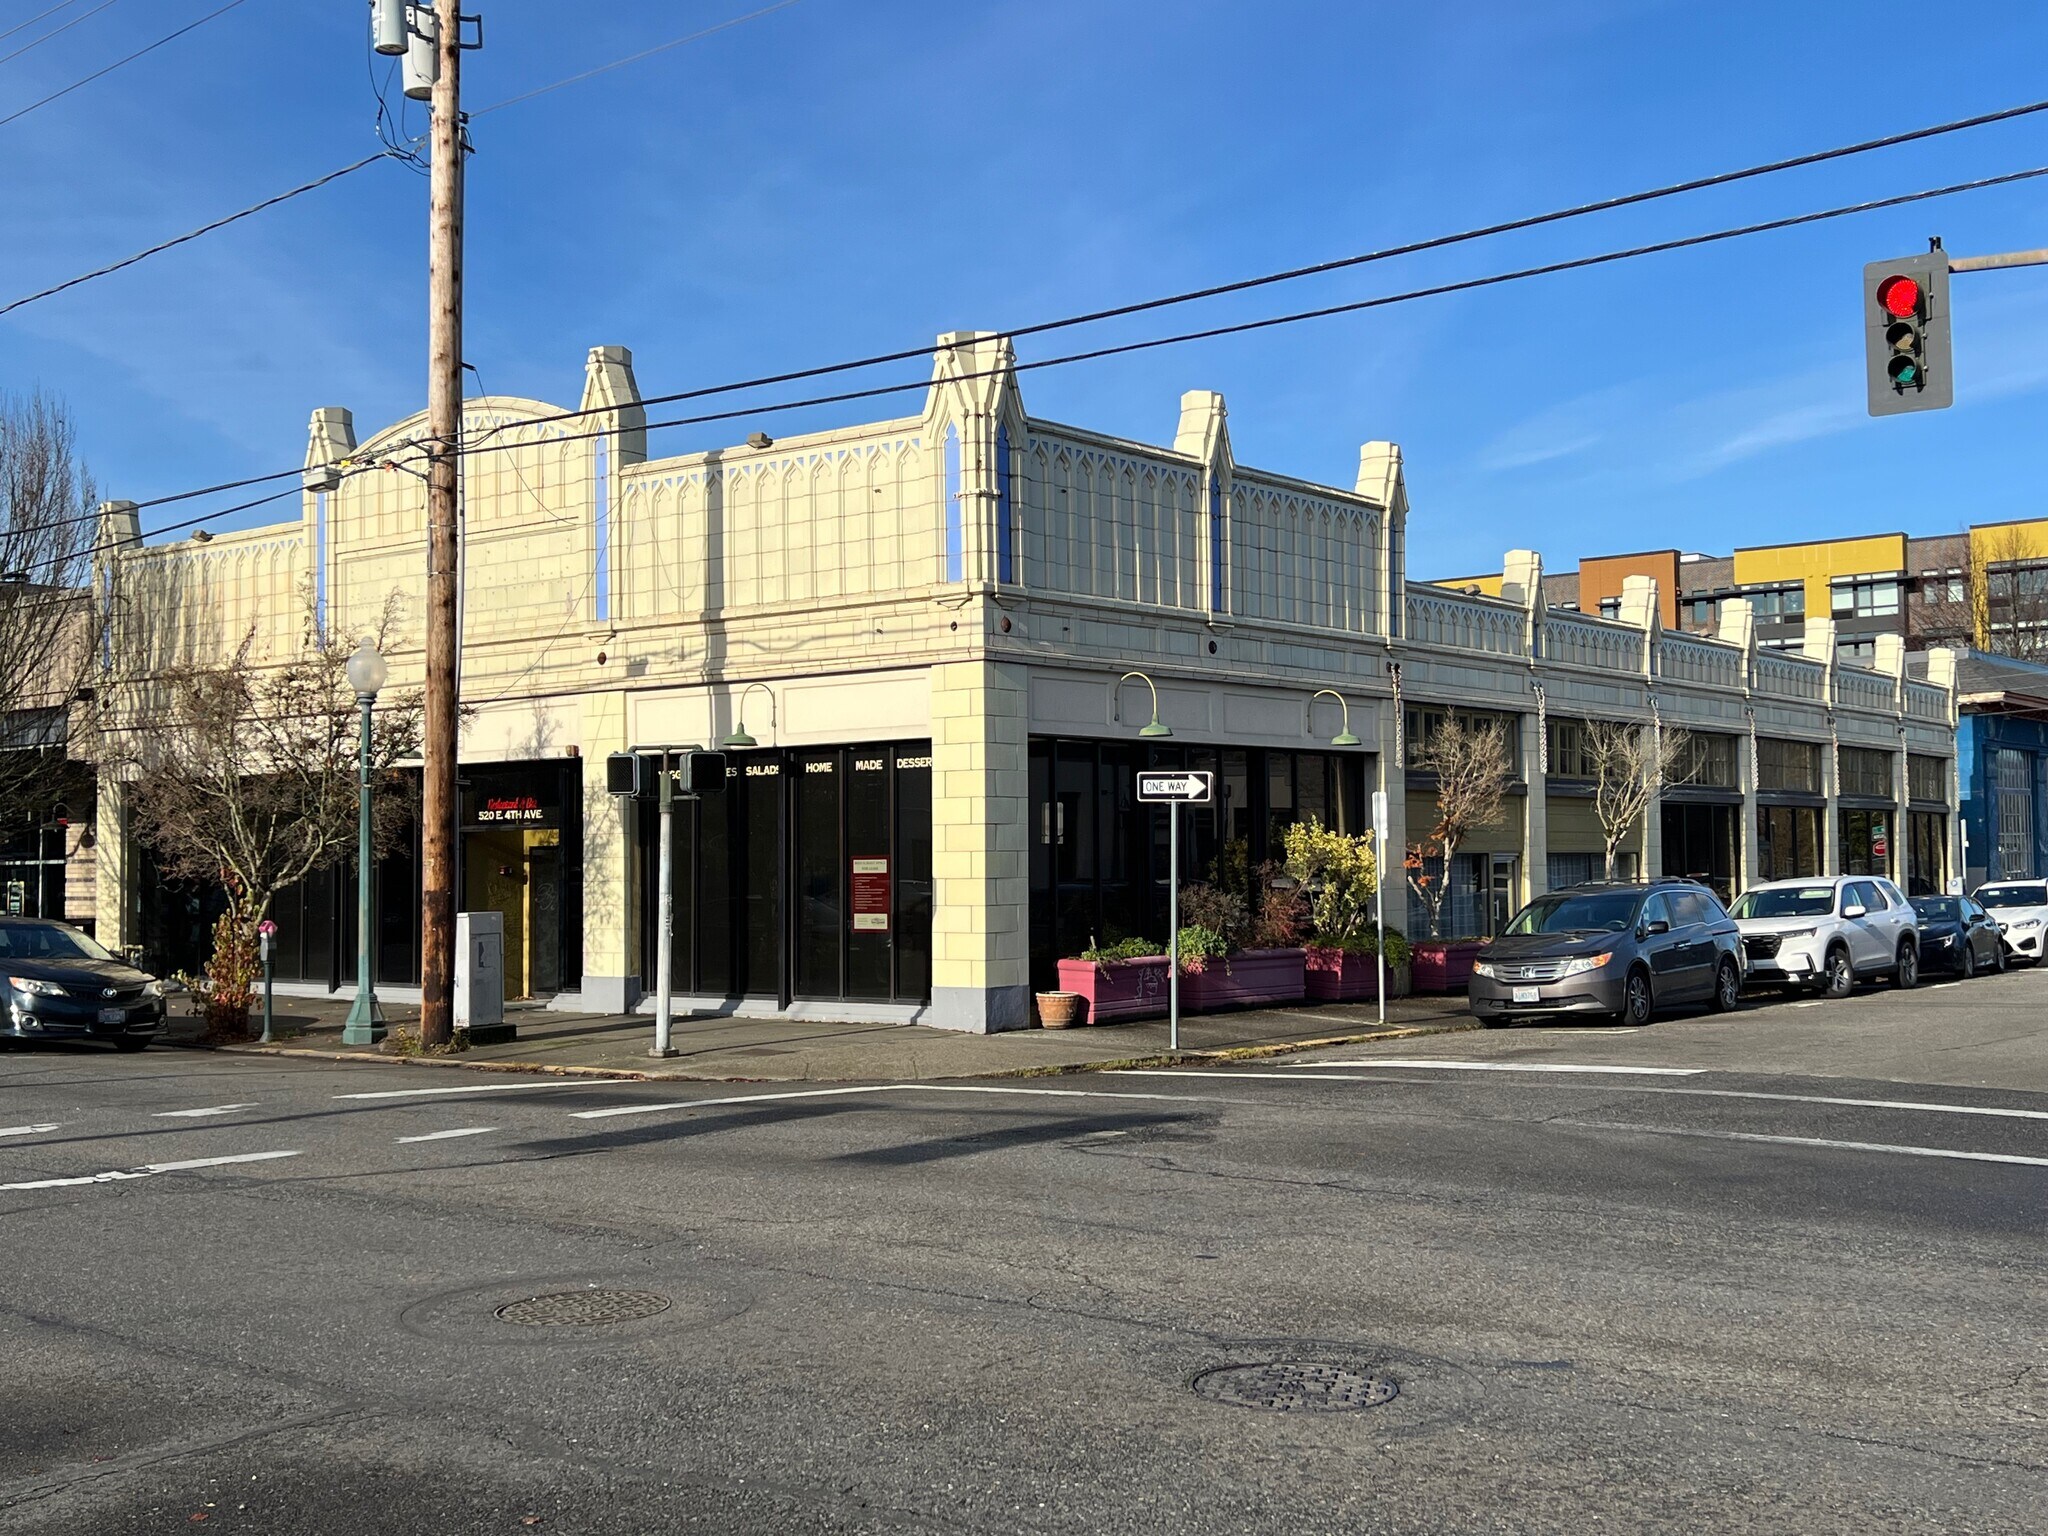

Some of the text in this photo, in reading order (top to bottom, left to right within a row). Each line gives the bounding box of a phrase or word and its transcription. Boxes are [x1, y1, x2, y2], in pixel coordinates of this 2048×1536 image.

[805, 762, 833, 773] HOME
[855, 759, 883, 771] MADE
[896, 757, 932, 769] DESSER
[1146, 782, 1187, 792] ONE WAY
[478, 810, 495, 821] 520
[504, 810, 522, 820] 4TH
[524, 809, 543, 819] AVE
